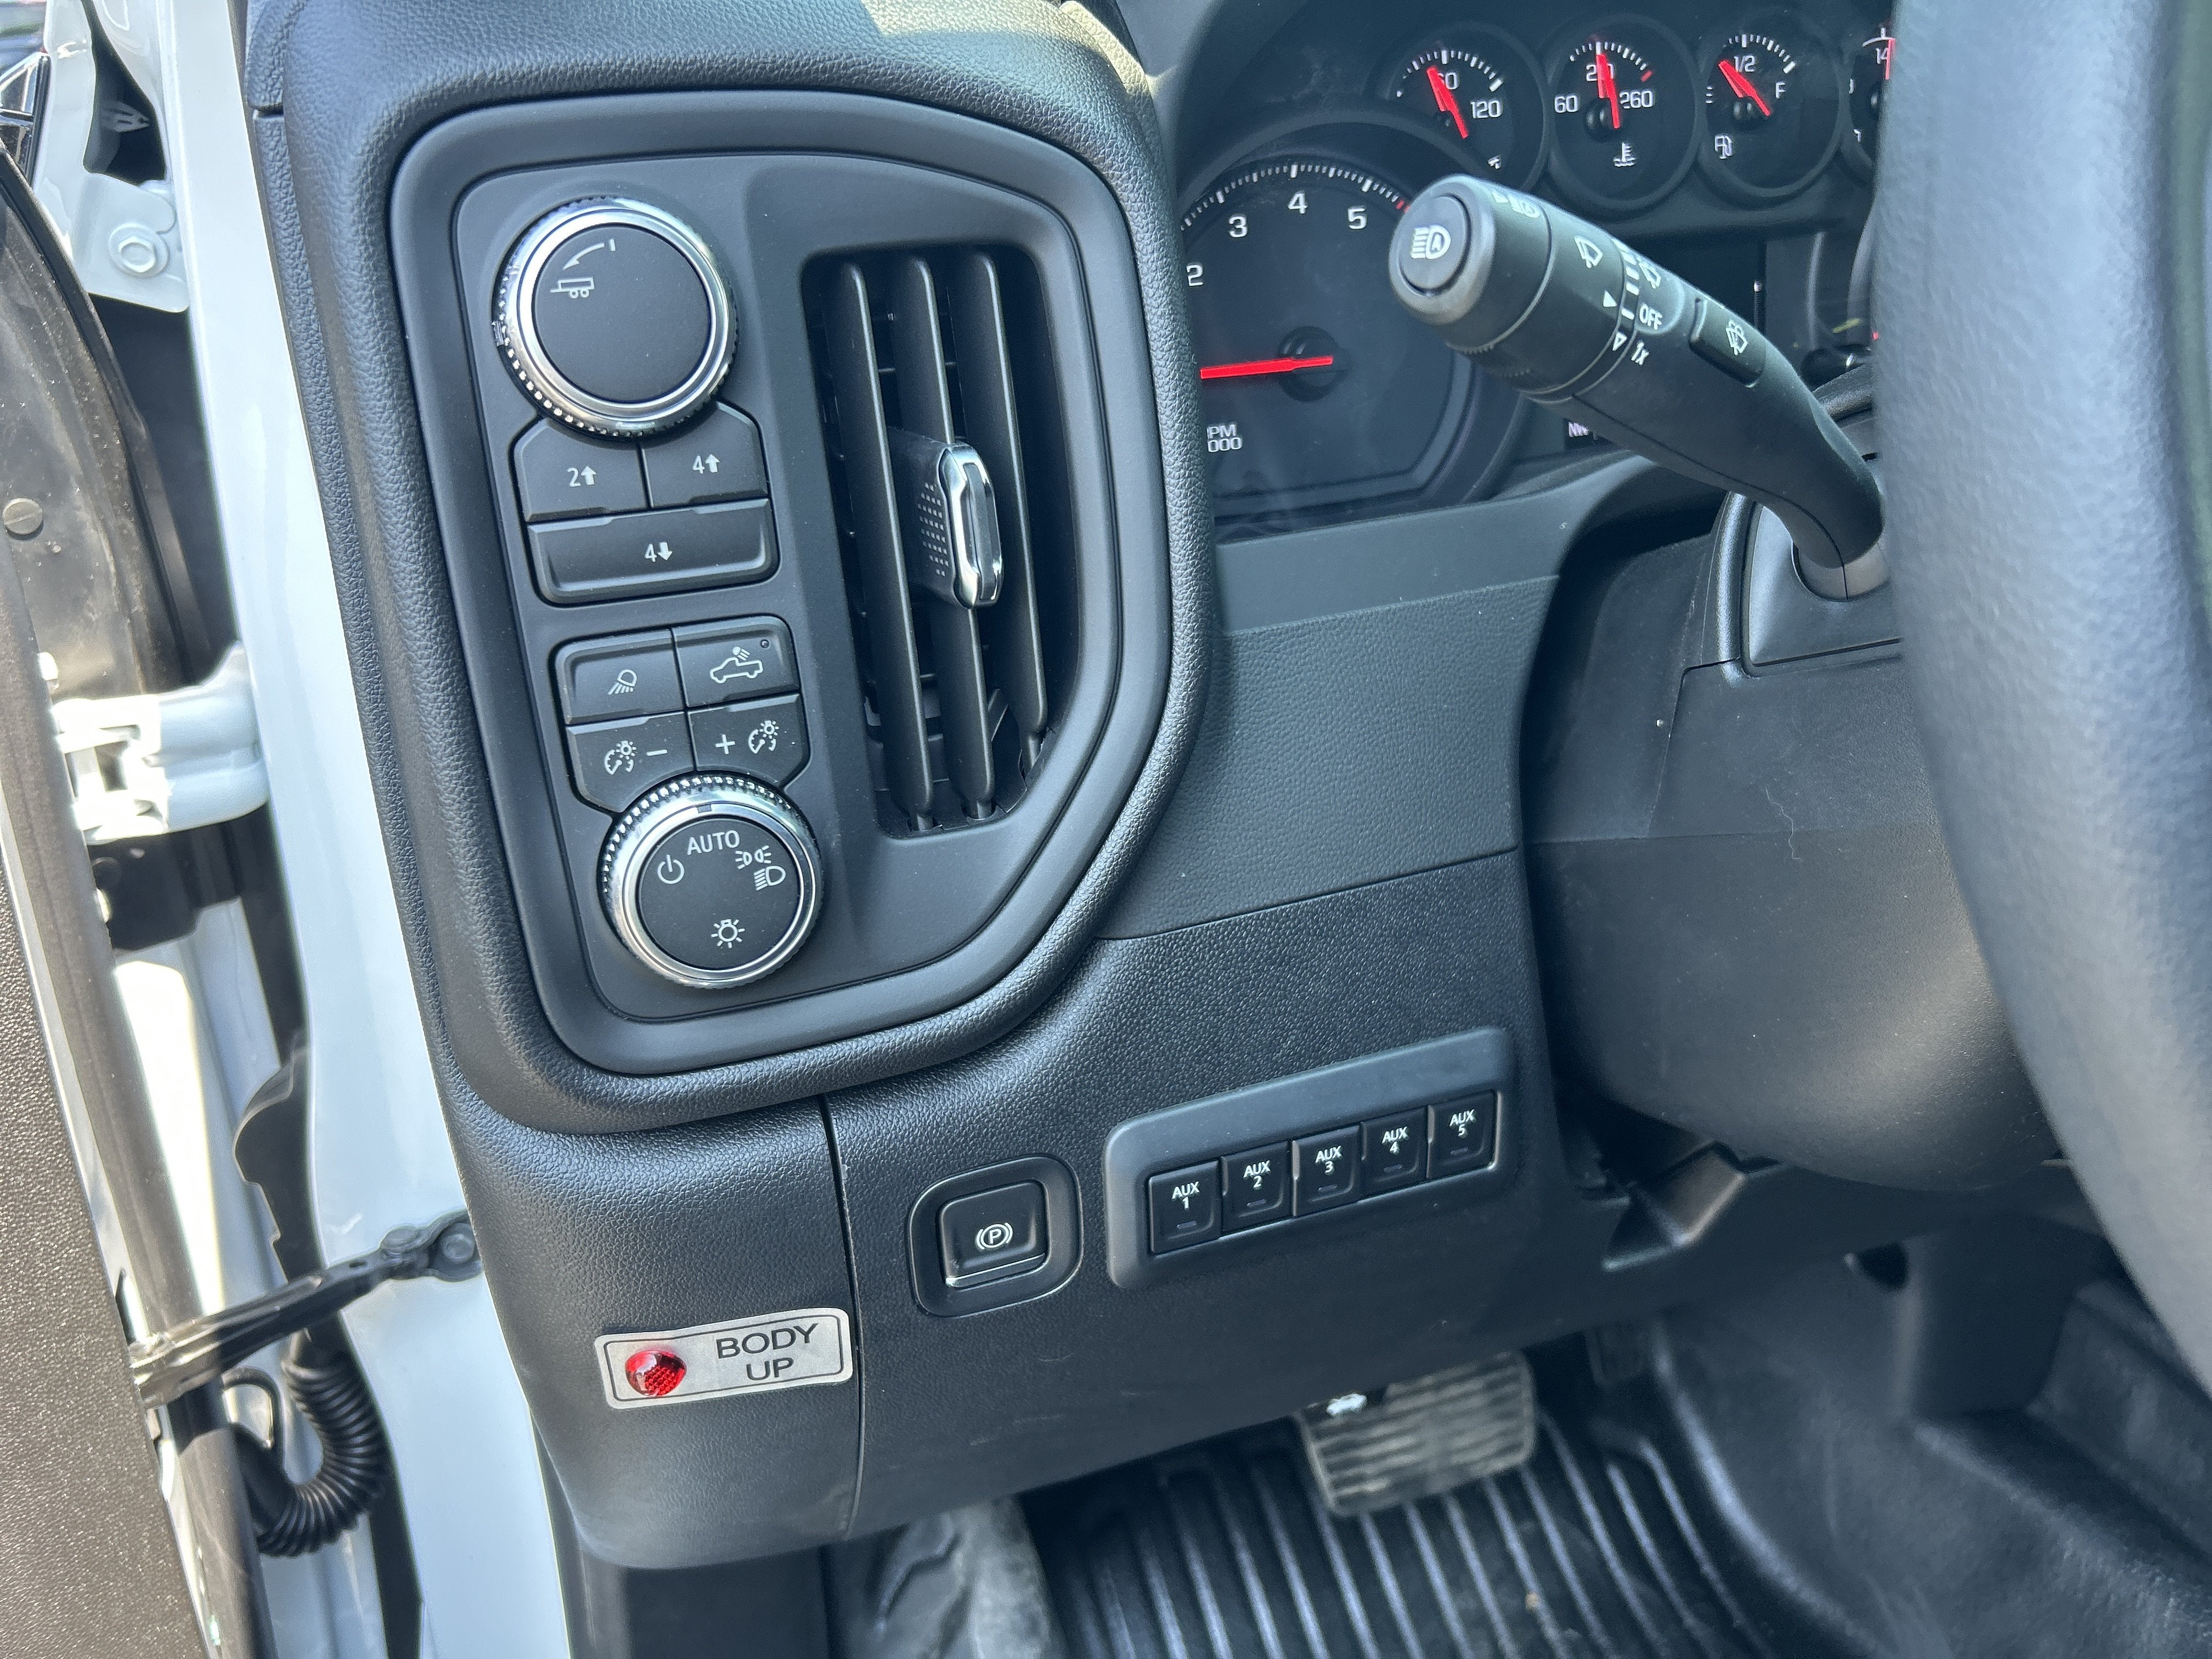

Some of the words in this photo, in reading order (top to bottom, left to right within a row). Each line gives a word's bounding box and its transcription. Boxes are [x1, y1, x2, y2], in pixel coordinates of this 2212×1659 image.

[1620, 89, 1654, 109] 260
[1775, 80, 1786, 99] F
[1471, 100, 1502, 119] 120
[1554, 94, 1578, 113] 60
[1288, 192, 1308, 214] 4
[1228, 215, 1248, 238] 3
[1348, 207, 1368, 230] 5
[1186, 263, 1204, 286] 2
[1639, 303, 1663, 330] OFF
[1631, 341, 1649, 365] 1x
[1207, 424, 1237, 439] PM
[692, 456, 706, 475] 4
[567, 467, 582, 487] 2
[644, 544, 657, 561] 4
[686, 830, 741, 855] AUTO
[1449, 1109, 1476, 1126] AUX
[1382, 1126, 1408, 1144] AUX
[1458, 1125, 1466, 1137] 5
[1316, 1146, 1342, 1163] AUX
[1390, 1141, 1399, 1153] 4
[1243, 1160, 1271, 1178] AUX
[1325, 1161, 1334, 1174] 3
[1172, 1181, 1200, 1199] AUX
[1253, 1175, 1262, 1189] 2
[1182, 1197, 1189, 1210] 1
[716, 1323, 819, 1359] BODY
[746, 1357, 794, 1381] UP
